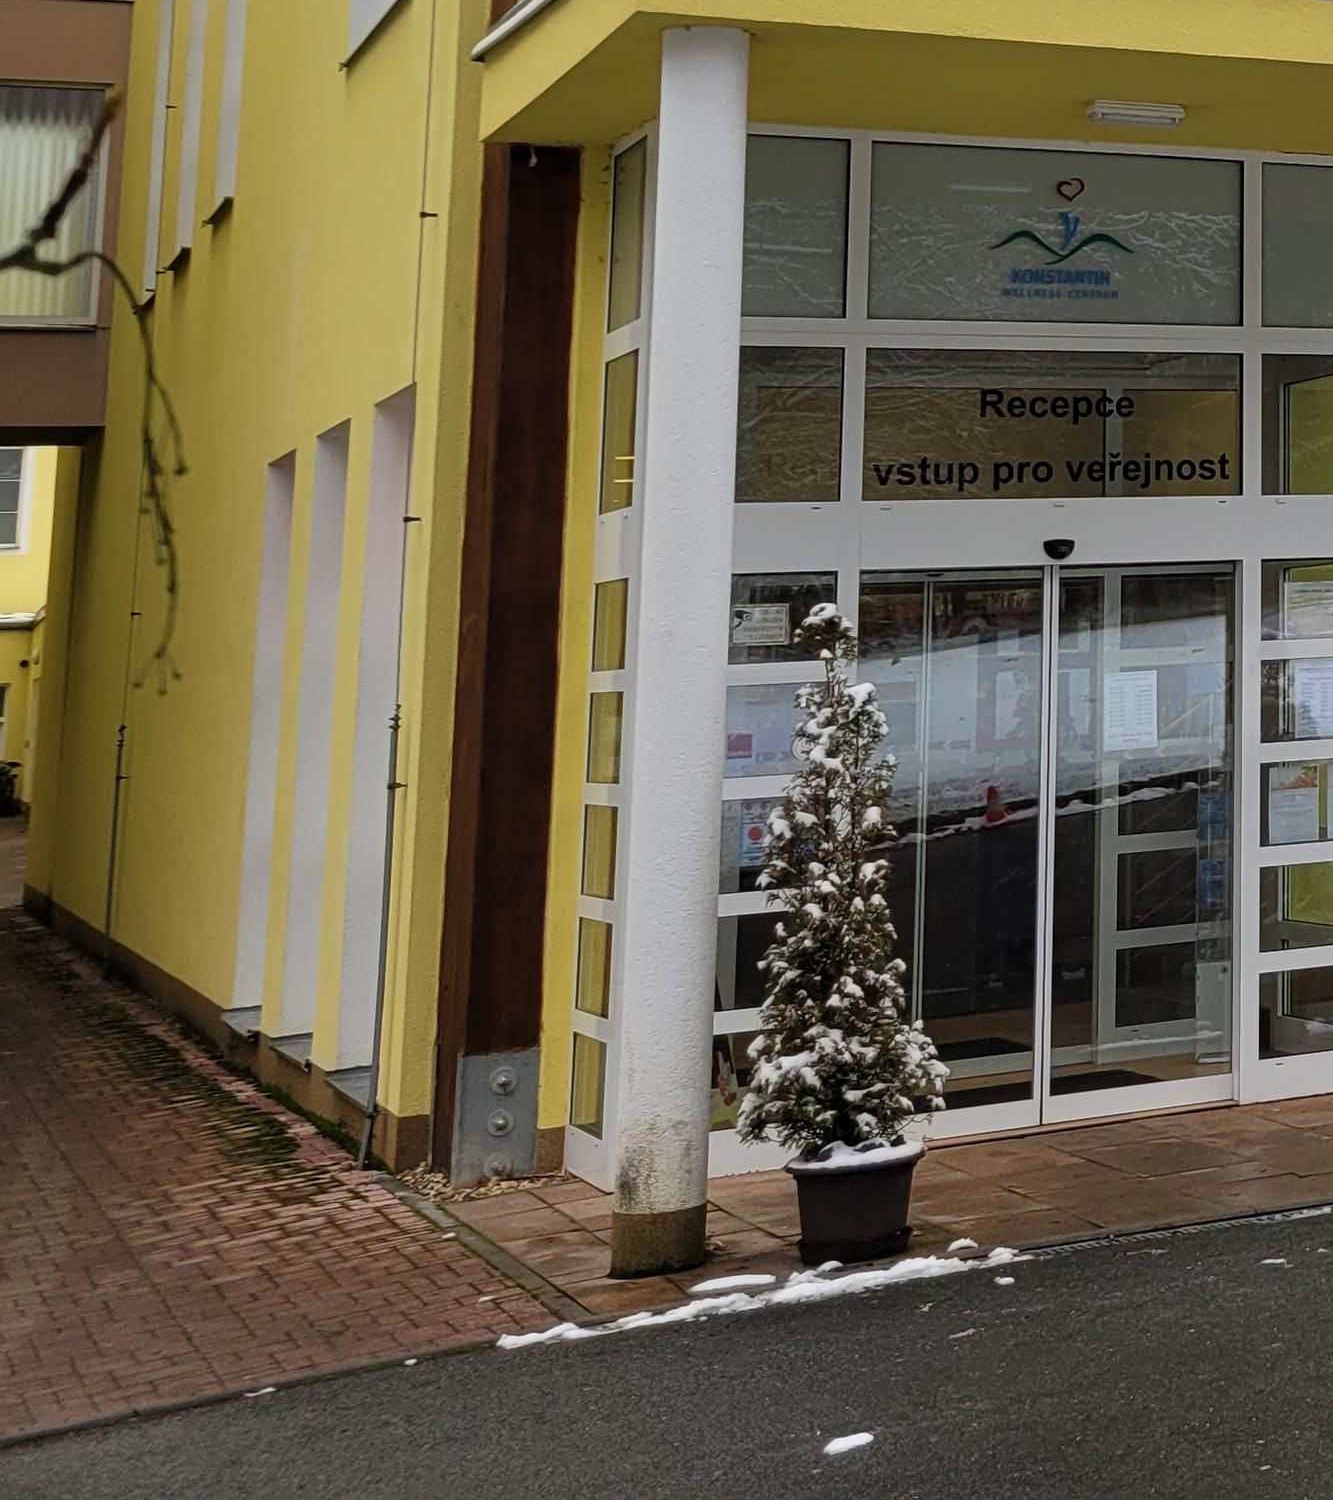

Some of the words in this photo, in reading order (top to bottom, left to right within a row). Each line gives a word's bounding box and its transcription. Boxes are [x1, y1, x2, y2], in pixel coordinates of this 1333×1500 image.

[1011, 268, 1111, 286] KONSTANTIN
[979, 388, 1135, 425] Recepce
[872, 456, 979, 492] vstup
[993, 460, 1054, 491] pro
[1065, 452, 1230, 489] veřejnost
